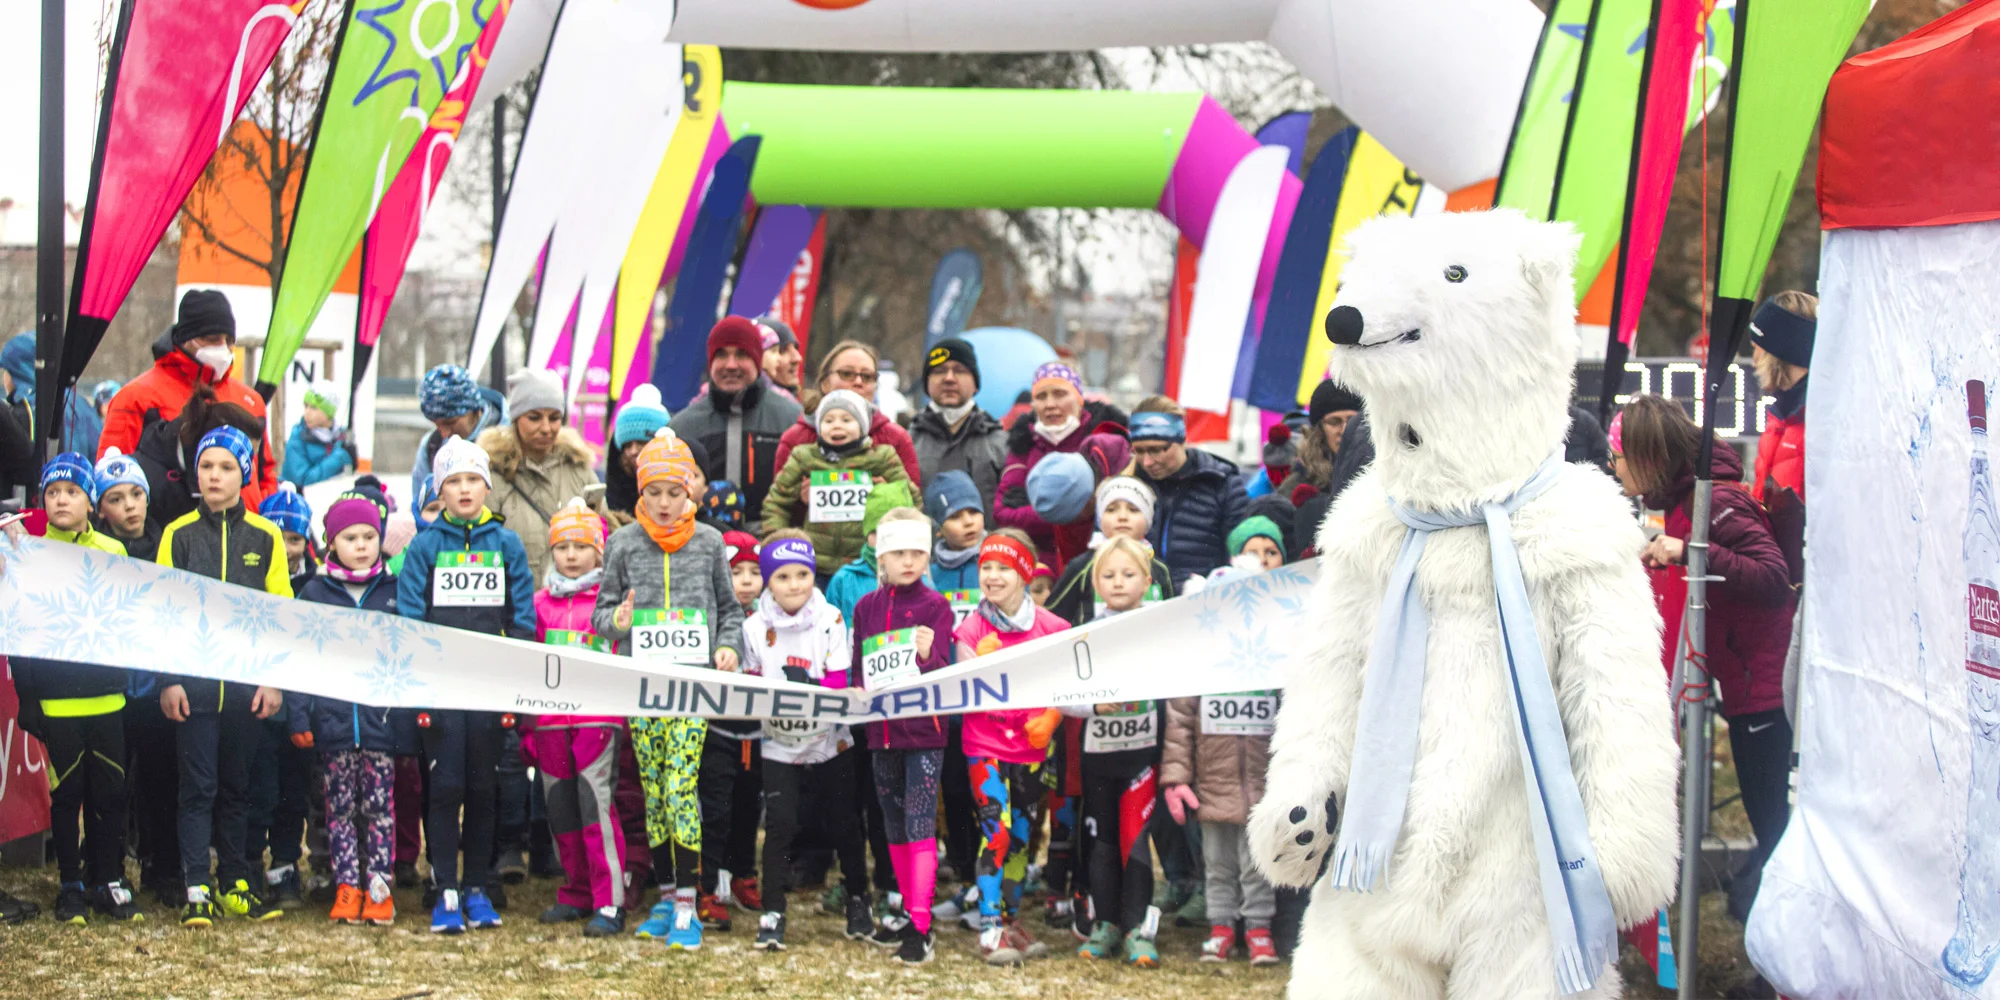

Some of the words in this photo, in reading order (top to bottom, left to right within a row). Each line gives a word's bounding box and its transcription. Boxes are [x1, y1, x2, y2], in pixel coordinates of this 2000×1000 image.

[816, 488, 868, 508] 3028
[441, 572, 498, 590] 3078
[639, 630, 701, 649] 3065
[868, 648, 914, 677] 3087
[638, 676, 850, 718] WINTER
[893, 673, 1009, 714] RUN
[1208, 700, 1270, 720] 3045
[1092, 716, 1152, 739] 3084
